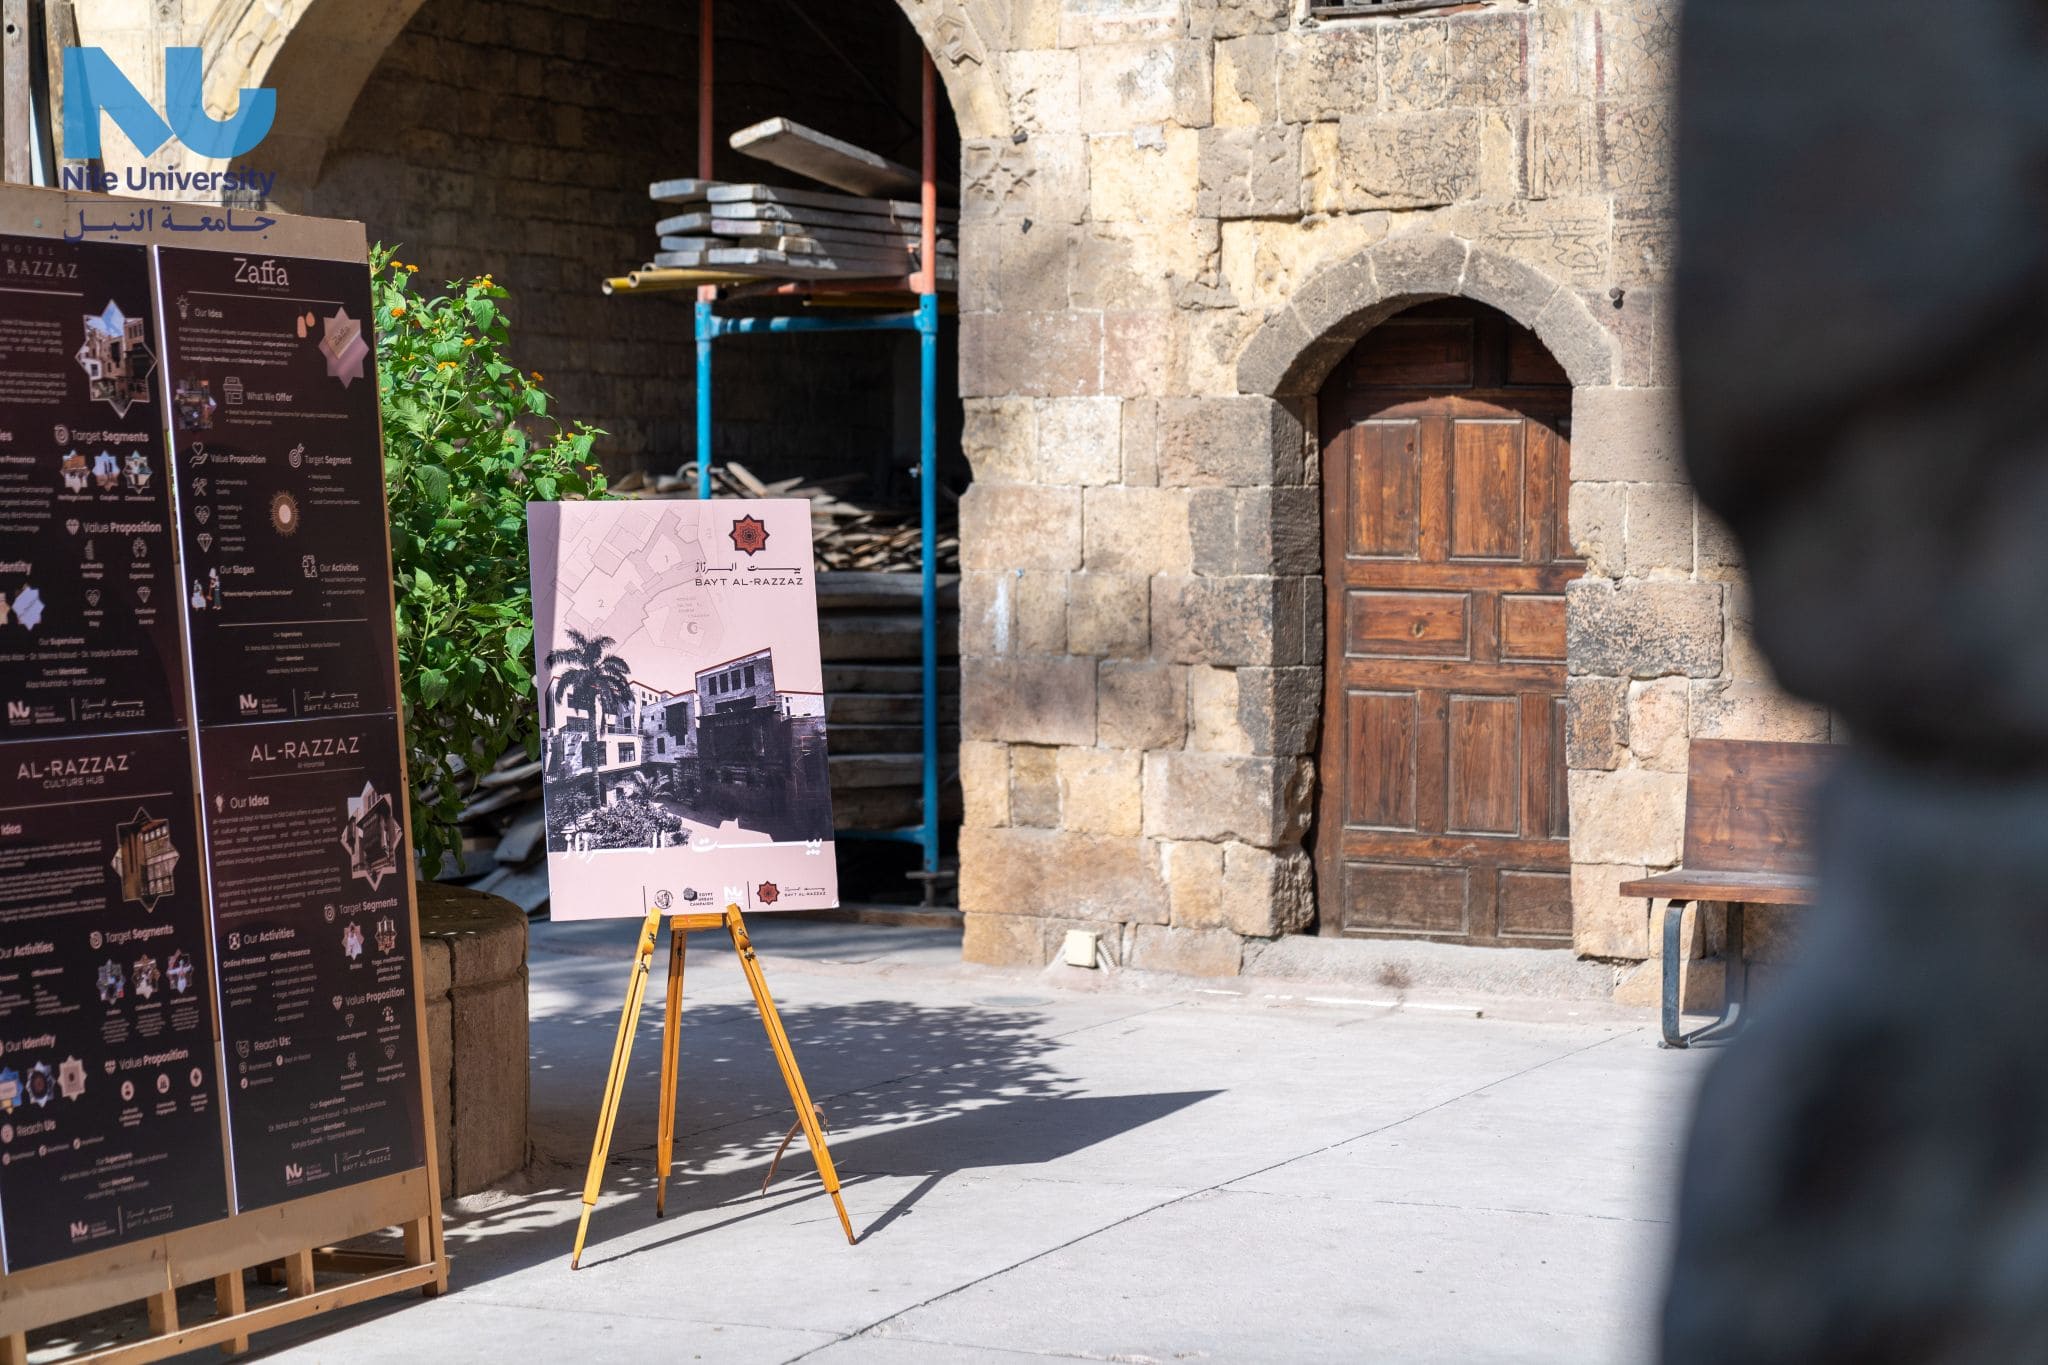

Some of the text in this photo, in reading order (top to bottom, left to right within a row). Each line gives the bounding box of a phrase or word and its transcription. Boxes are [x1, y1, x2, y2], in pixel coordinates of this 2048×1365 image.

[6, 259, 79, 279] RAZZAZ
[233, 257, 289, 287] Zaffa
[195, 308, 223, 319] Our Idea
[246, 392, 293, 403] What We Offer
[72, 430, 149, 445] Target Segments
[211, 454, 266, 465] Value Proposition
[305, 455, 352, 467] Target Segment
[83, 521, 162, 536] Value Proposition
[0, 560, 32, 576] dentity
[220, 565, 255, 576] Our Slogan
[320, 563, 359, 573] Our Activities
[695, 577, 803, 586] BAYT AL-RAZZAZ
[250, 736, 360, 763] AL-RAZZAZ
[17, 754, 129, 780] AL-RAZZAZ
[43, 775, 105, 789] CULTURE HUB
[230, 795, 270, 809] Our Idea
[339, 897, 398, 916] Target Segments
[105, 924, 174, 945] Target Segments
[244, 928, 295, 944] Our Activities
[13, 941, 54, 958] Activities
[346, 987, 405, 1007] Value Proposition
[5, 1033, 56, 1052] Our Identity
[254, 1038, 278, 1051] Reach
[119, 1048, 189, 1070] Value Proposition
[16, 1119, 56, 1137] Reach Us
